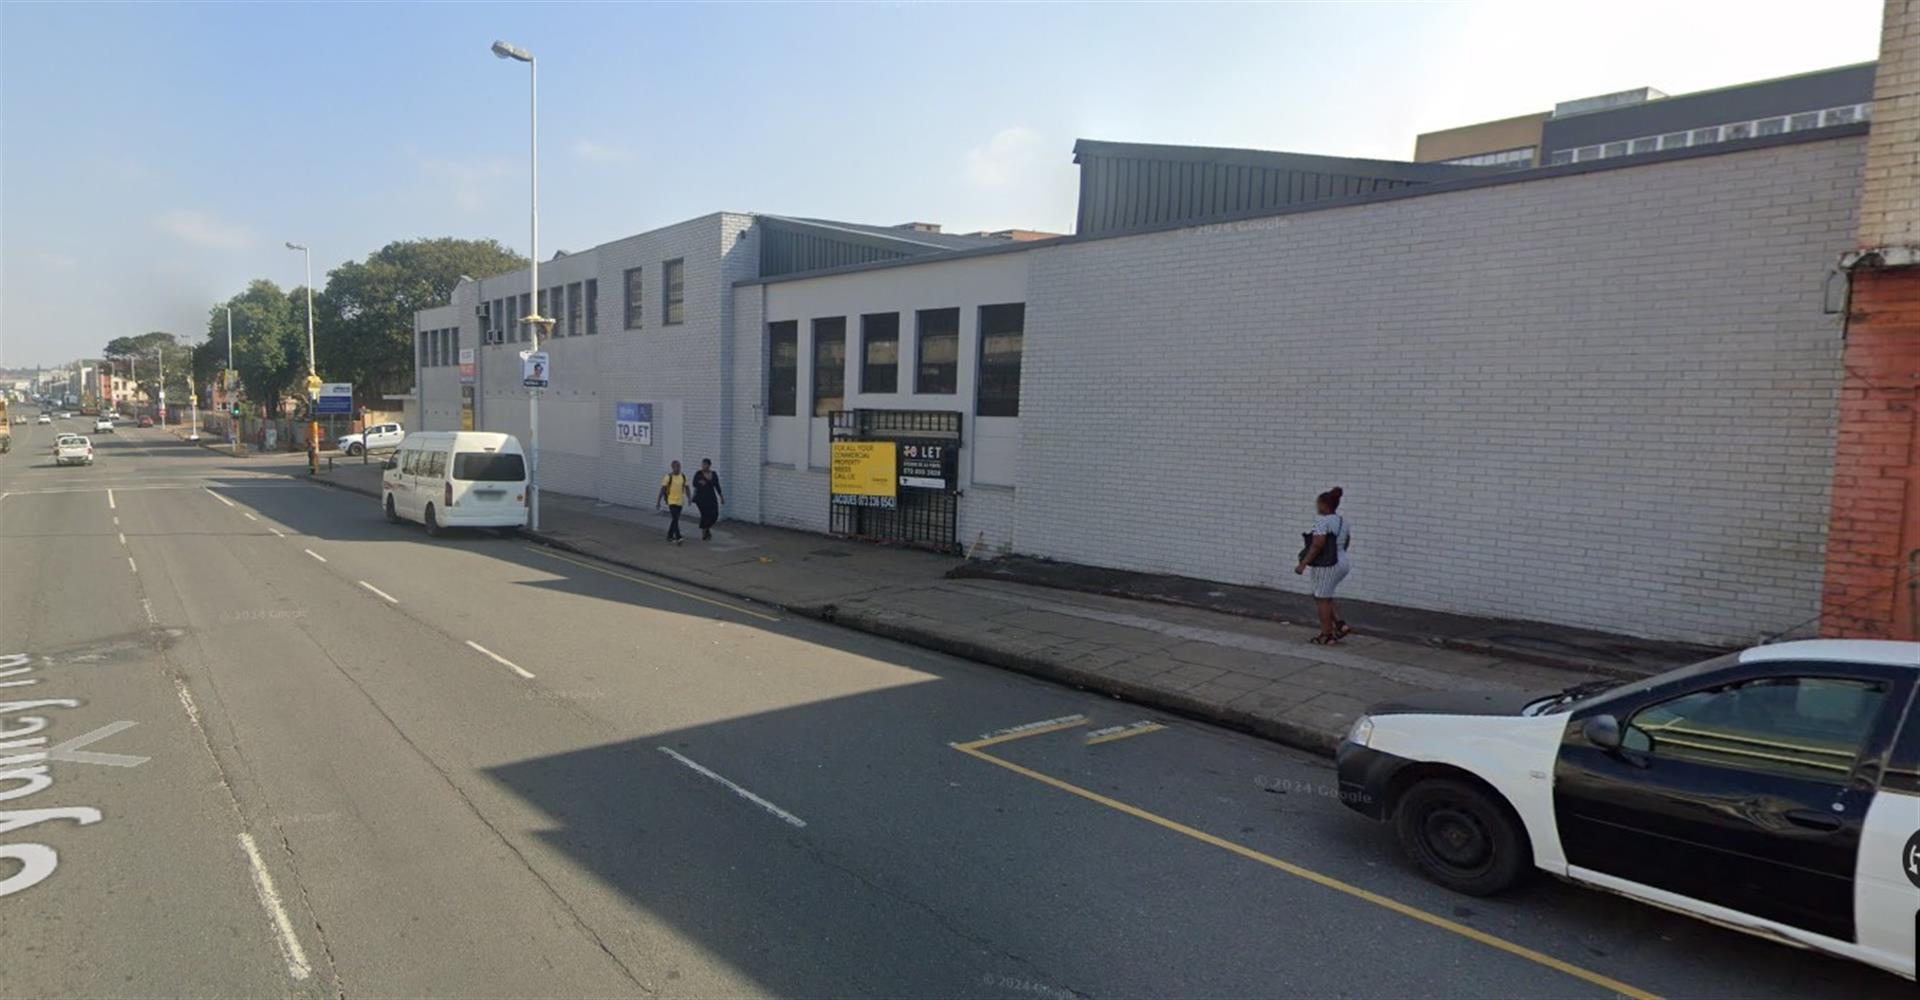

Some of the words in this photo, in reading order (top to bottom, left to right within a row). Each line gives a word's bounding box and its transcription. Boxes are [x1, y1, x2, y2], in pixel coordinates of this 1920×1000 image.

[618, 424, 630, 436] TO
[633, 424, 649, 438] LET
[921, 446, 942, 458] LET
